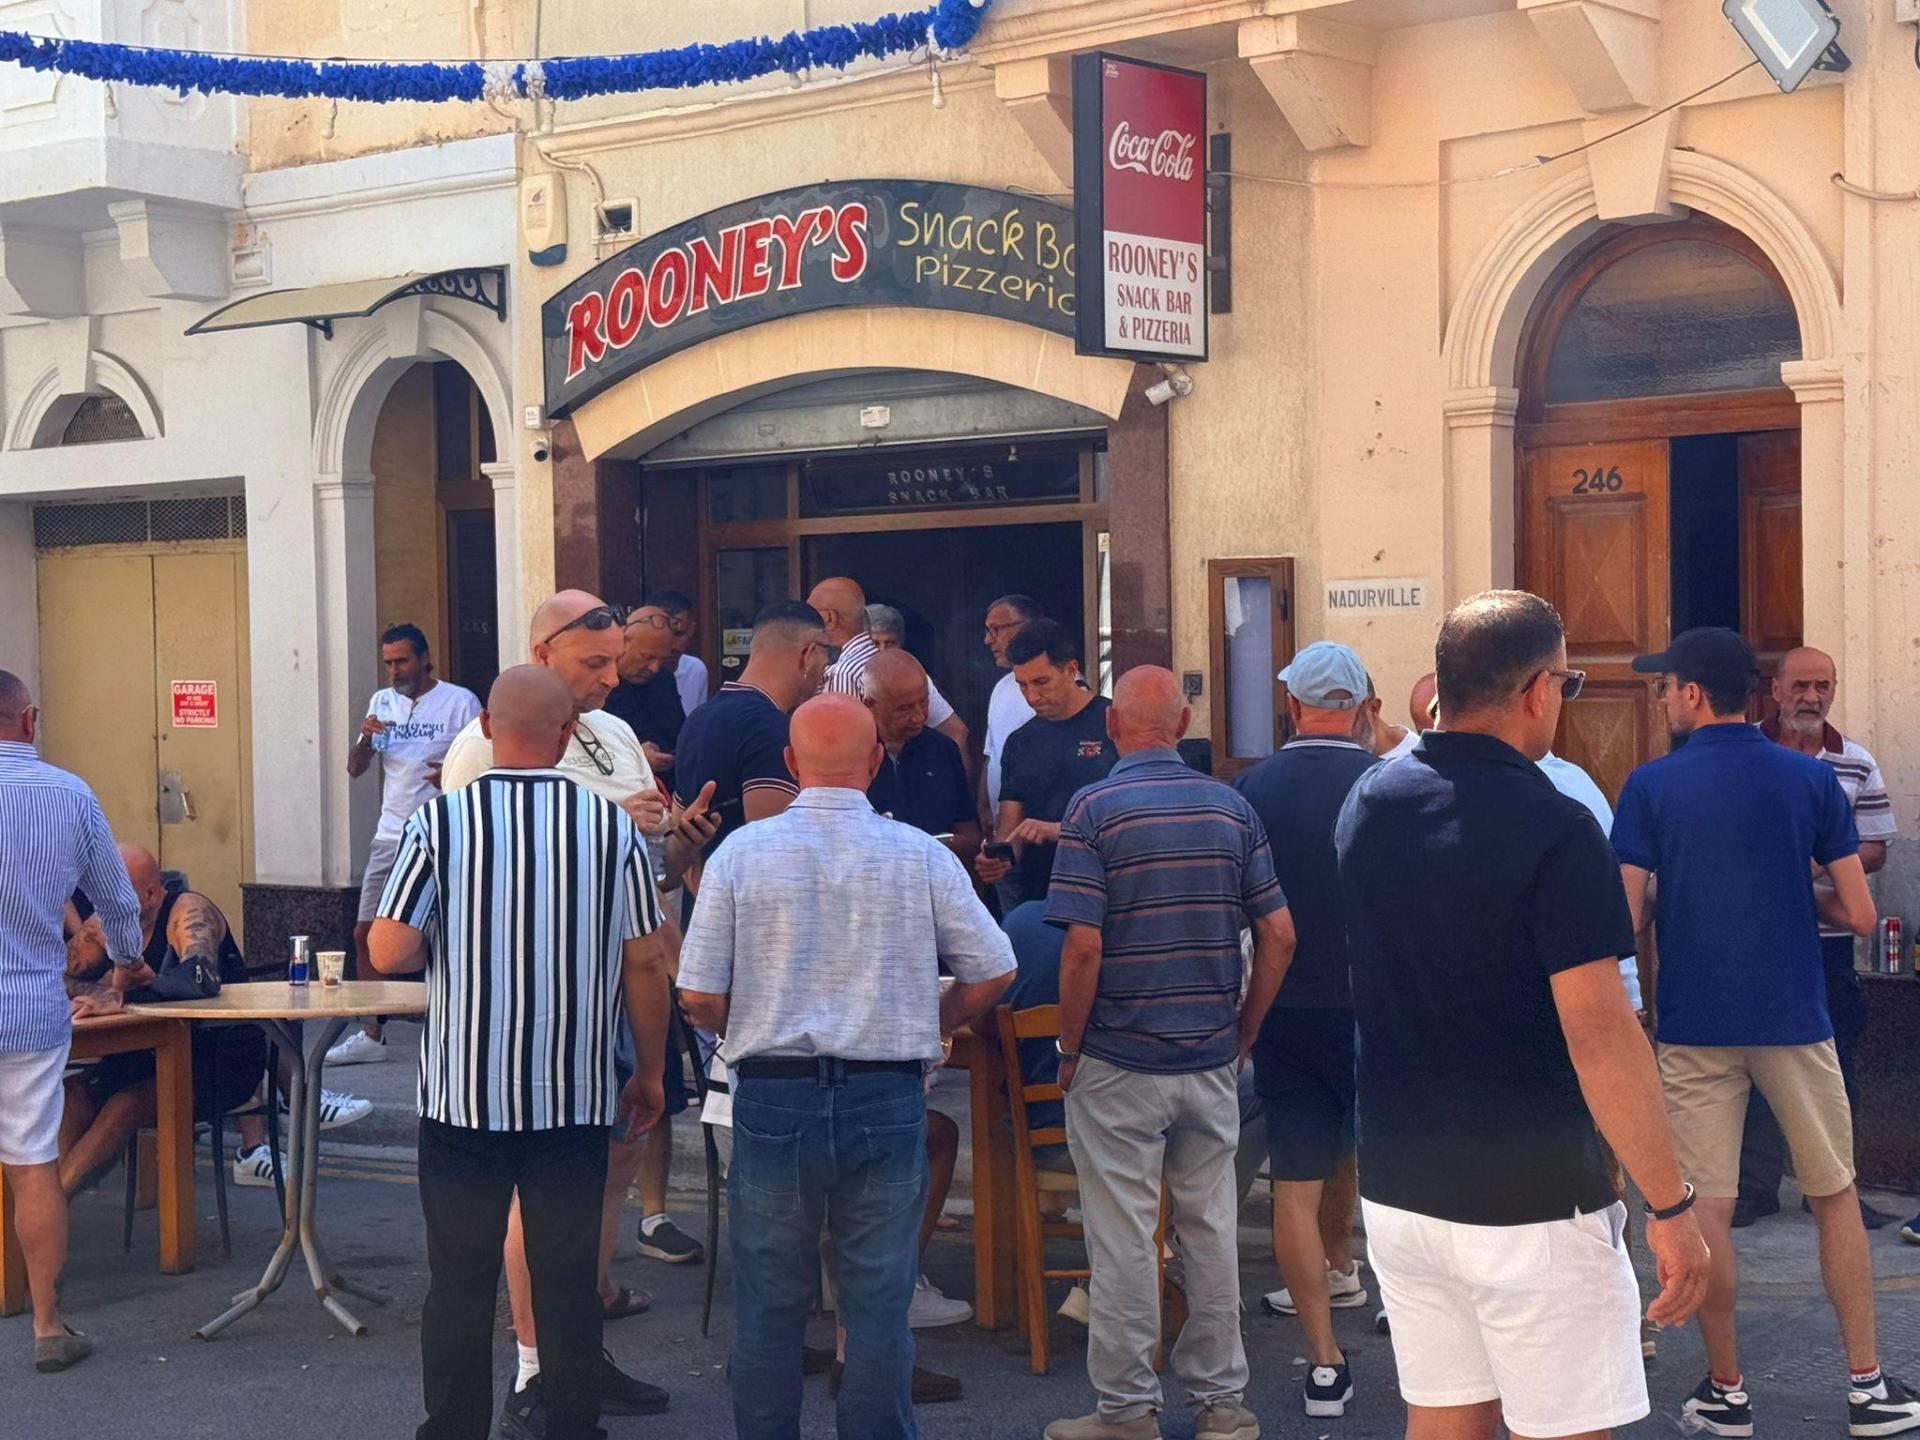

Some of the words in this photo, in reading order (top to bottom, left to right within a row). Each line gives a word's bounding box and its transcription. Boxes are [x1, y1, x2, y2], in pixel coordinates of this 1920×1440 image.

[897, 202, 1025, 261] Snack
[1108, 240, 1198, 283] ROONEY'S
[564, 202, 868, 385] ROONEY'S
[1117, 283, 1161, 311] SNACK
[1166, 289, 1192, 315] BAR
[1118, 315, 1129, 339] &
[1132, 316, 1192, 345] PIZZERIA
[887, 464, 994, 486] ROONEY'S
[1572, 465, 1624, 495] 246
[1328, 587, 1421, 609] NADURVILLE
[174, 684, 214, 695] GARAGE
